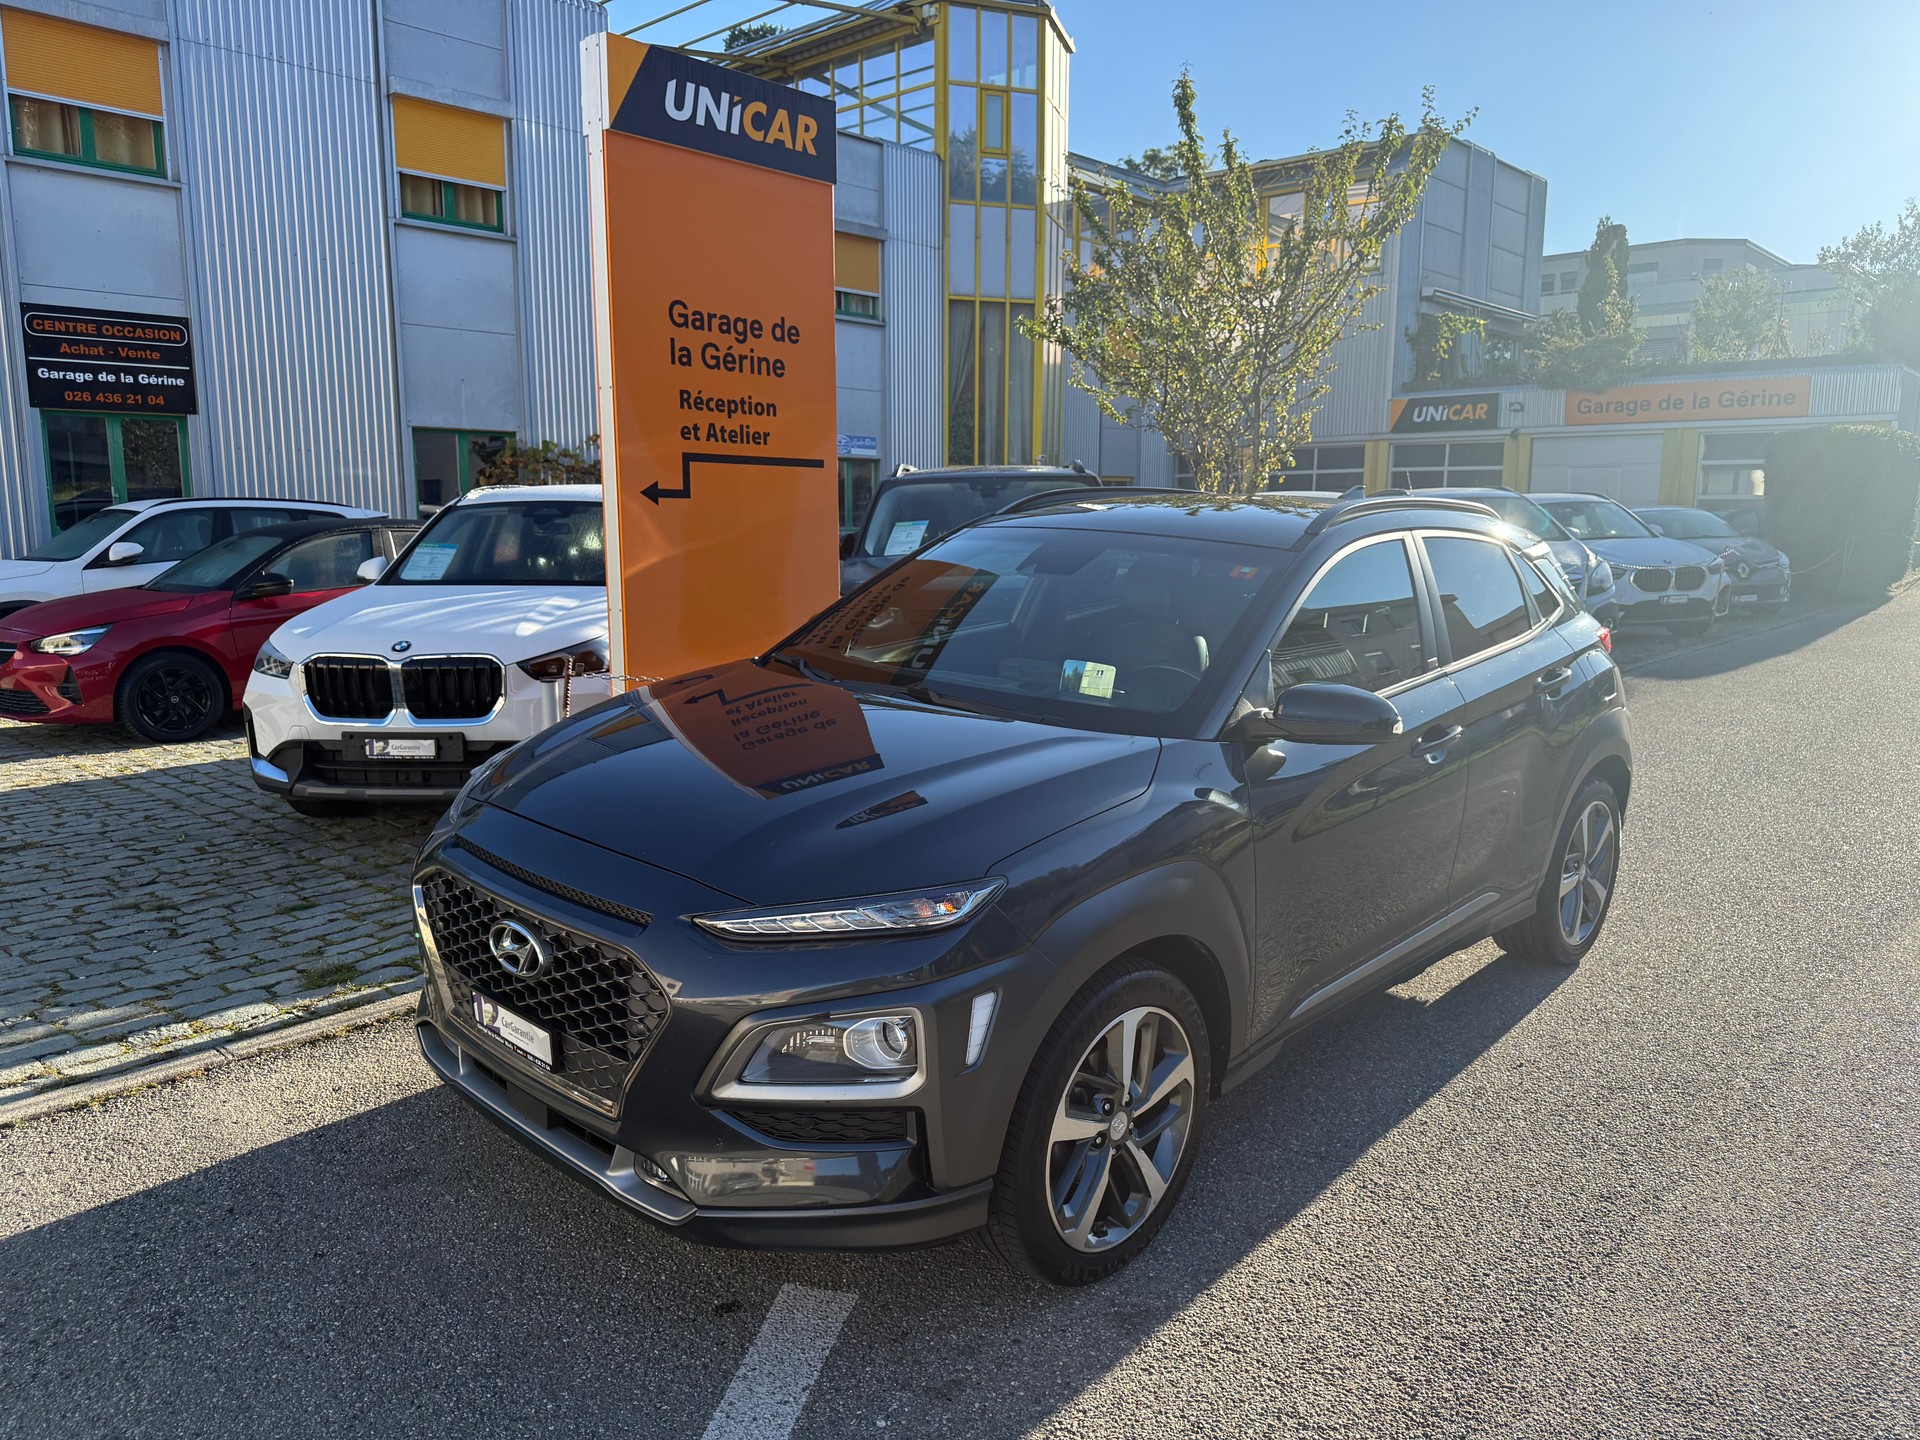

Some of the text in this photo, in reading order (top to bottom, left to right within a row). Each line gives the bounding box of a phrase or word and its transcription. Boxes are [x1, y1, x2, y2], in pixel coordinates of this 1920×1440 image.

[32, 319, 181, 341] CENTRE OCCASION
[668, 299, 800, 344] Garage de
[59, 342, 105, 356] Achat
[117, 346, 161, 360] Vente
[670, 337, 786, 378] la Gérine
[37, 367, 185, 387] Garage de la Gérine
[64, 390, 165, 406] 026 436 21 04
[679, 389, 777, 419] Réception
[1576, 388, 1797, 417] Garage de la Gérine
[680, 422, 770, 446] et Atelier
[365, 739, 391, 756] 12
[501, 1016, 535, 1044] CarGarantie
